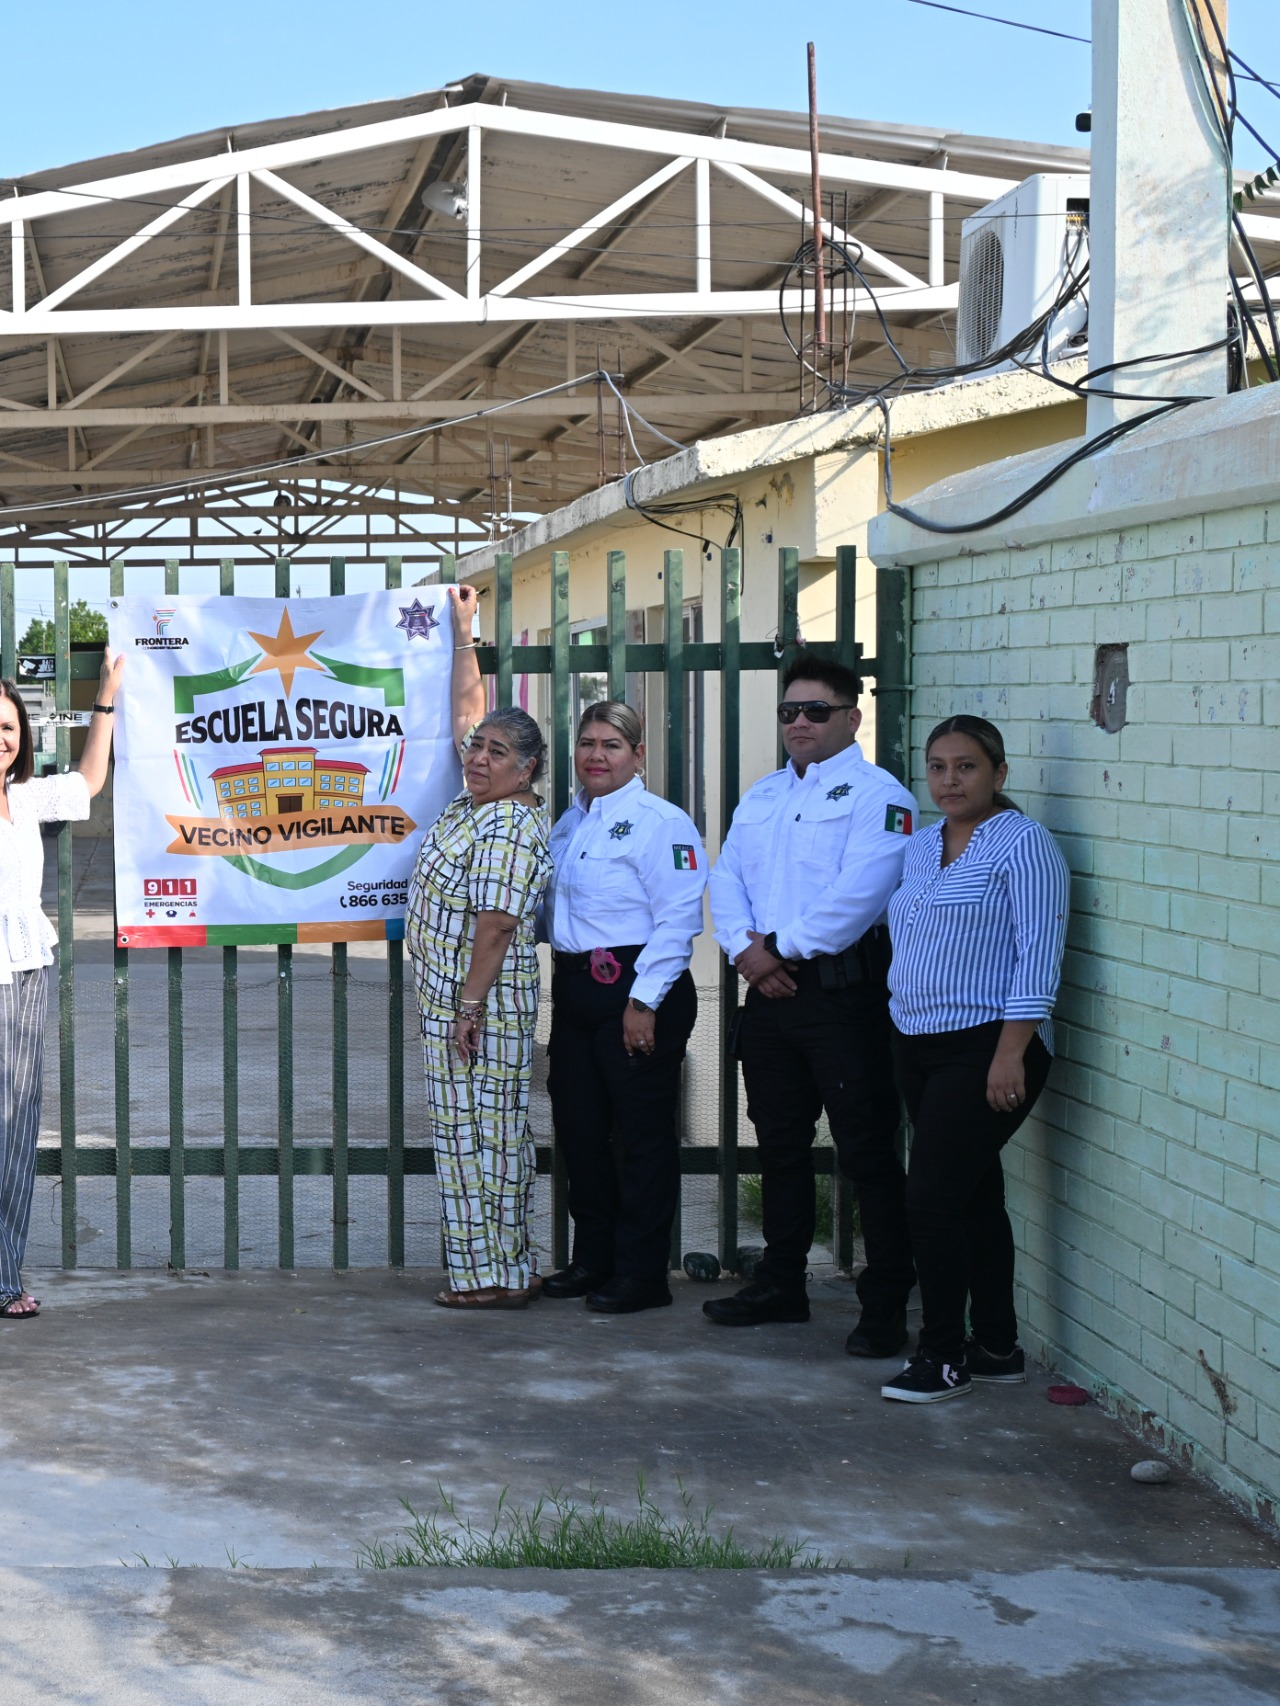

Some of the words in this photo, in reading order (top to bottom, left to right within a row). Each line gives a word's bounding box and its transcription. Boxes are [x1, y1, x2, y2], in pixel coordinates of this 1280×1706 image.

[135, 637, 189, 646] FRONTERA
[59, 713, 83, 721] INE
[175, 699, 293, 744] ESCUELA
[296, 698, 404, 741] SEGURA
[179, 824, 271, 847] VECINO
[278, 815, 405, 841] VIGILANTE
[147, 881, 192, 895] 911
[347, 879, 408, 893] Seguridad
[349, 895, 378, 907] 866
[381, 893, 408, 906] 635
